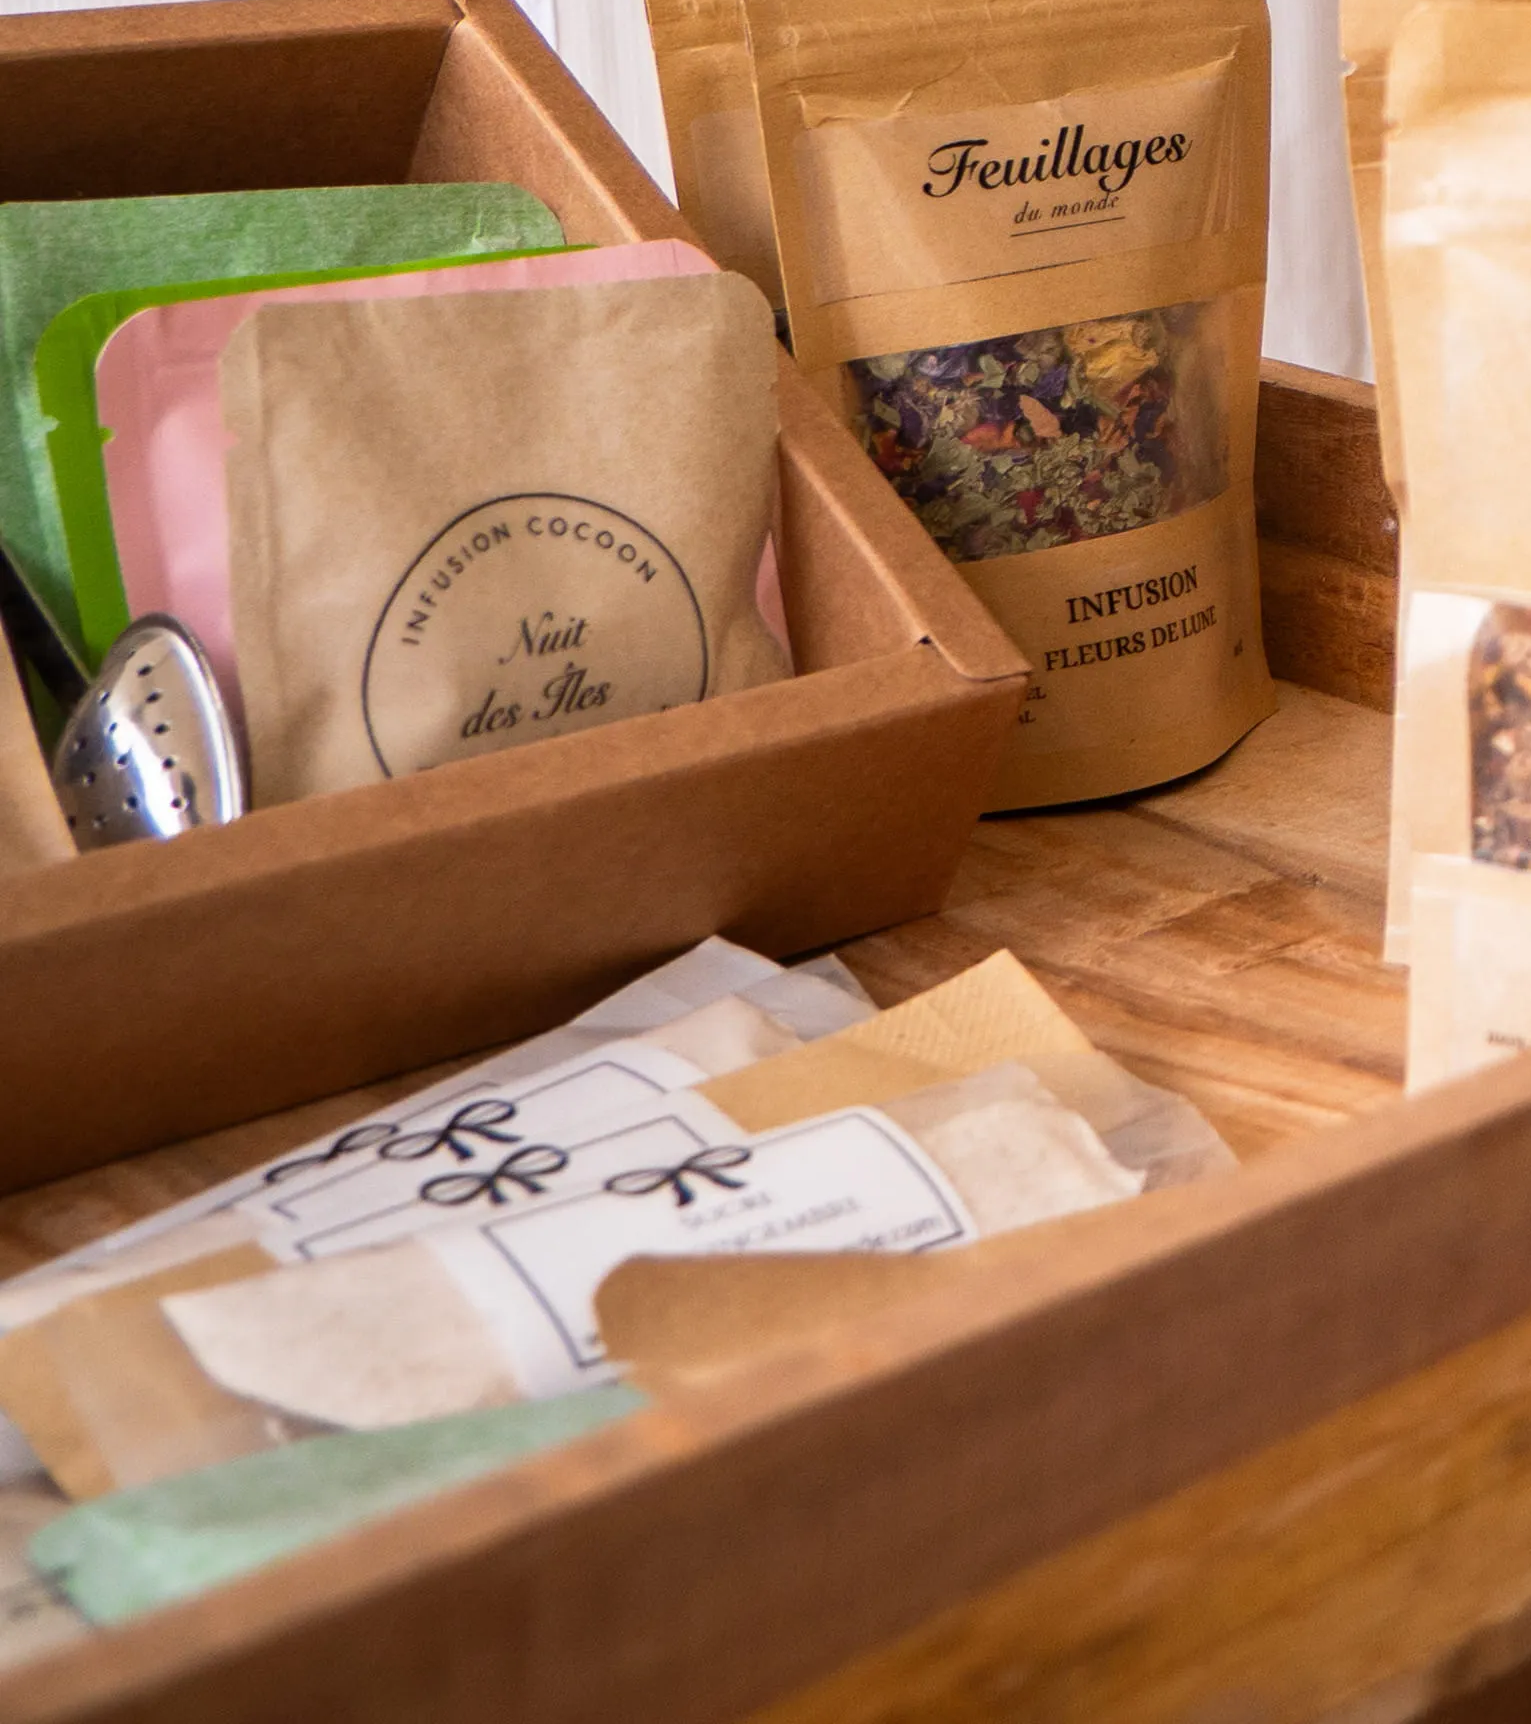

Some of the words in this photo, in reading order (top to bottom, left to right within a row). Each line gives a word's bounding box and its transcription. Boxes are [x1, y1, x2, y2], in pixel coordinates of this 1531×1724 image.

[922, 124, 1193, 198] Feuillages
[1013, 200, 1042, 225] du
[1050, 193, 1120, 219] monde
[400, 522, 513, 647] INFUSION
[526, 515, 658, 585] COCOON
[1065, 564, 1199, 624] INFUSION
[498, 610, 592, 666] Nuit
[1044, 630, 1147, 672] FLEURS
[1150, 620, 1180, 649] DE
[1181, 604, 1218, 639] LUNE
[460, 688, 523, 740] des
